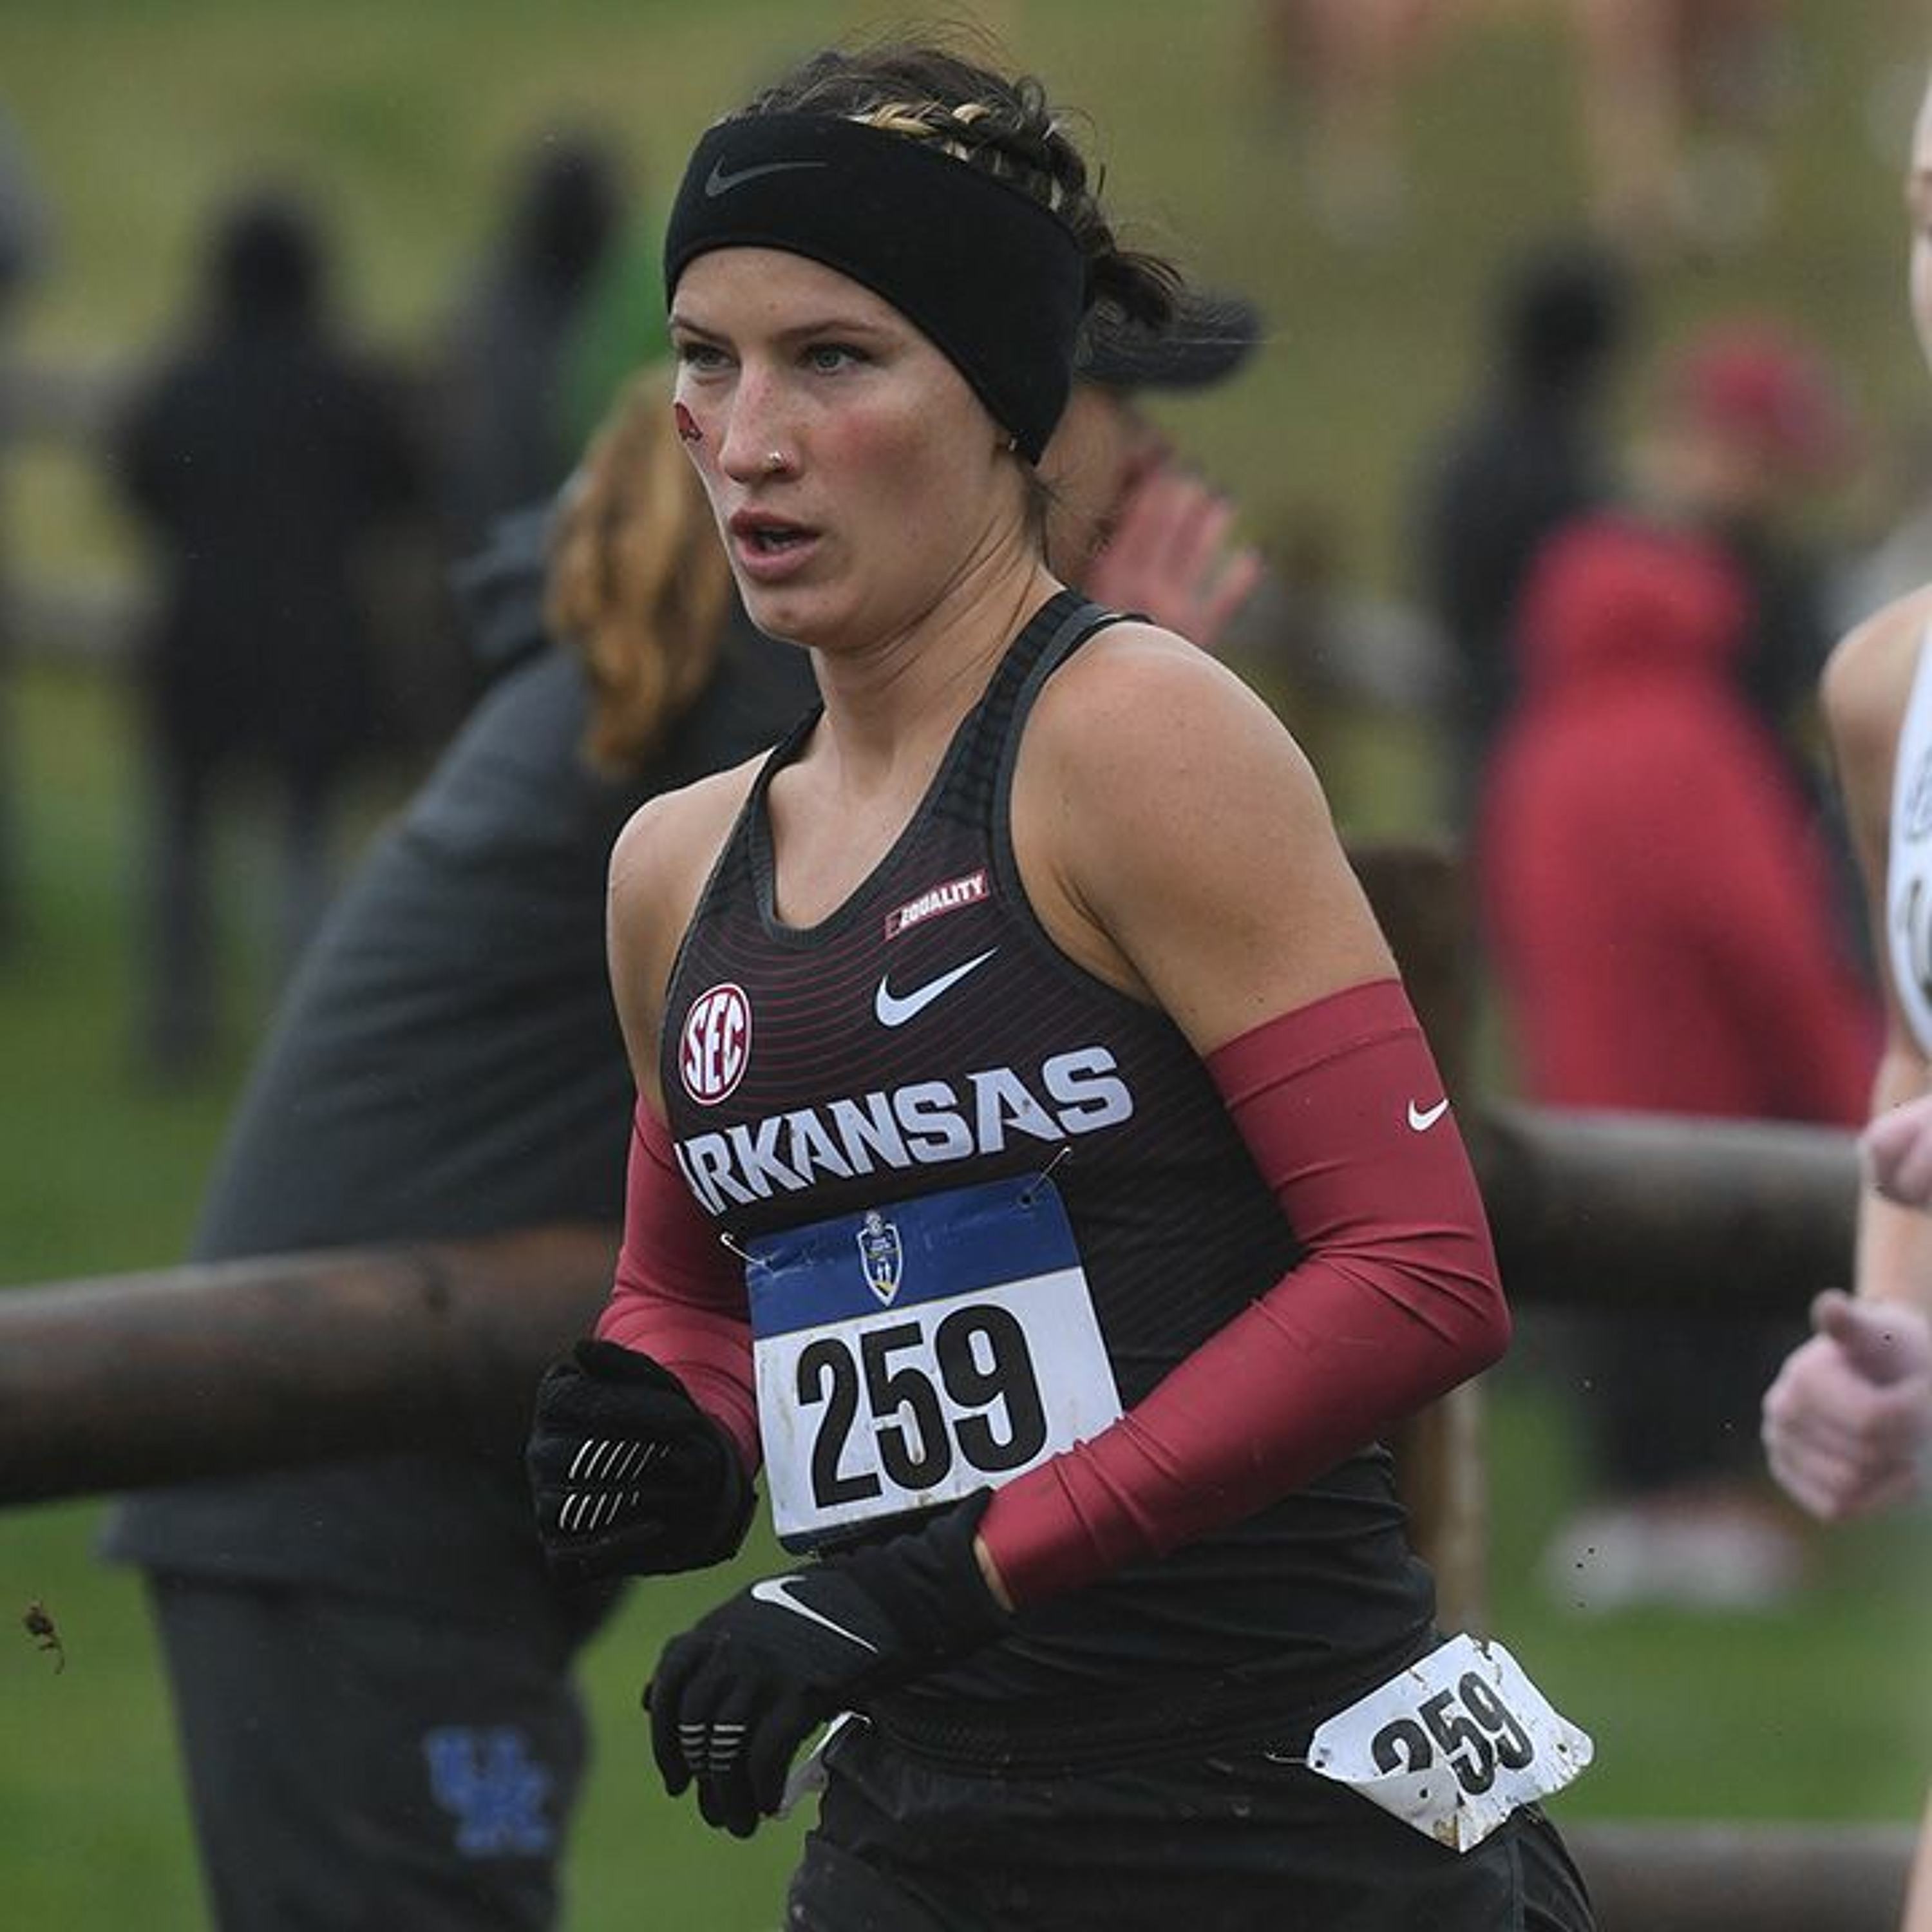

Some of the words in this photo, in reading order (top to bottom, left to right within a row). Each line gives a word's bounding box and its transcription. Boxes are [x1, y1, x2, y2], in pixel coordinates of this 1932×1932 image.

[901, 874, 983, 929] EQUALITY
[686, 992, 744, 1093] SEC
[674, 1046, 1134, 1216] RKANSAS
[797, 1304, 1048, 1508] 259
